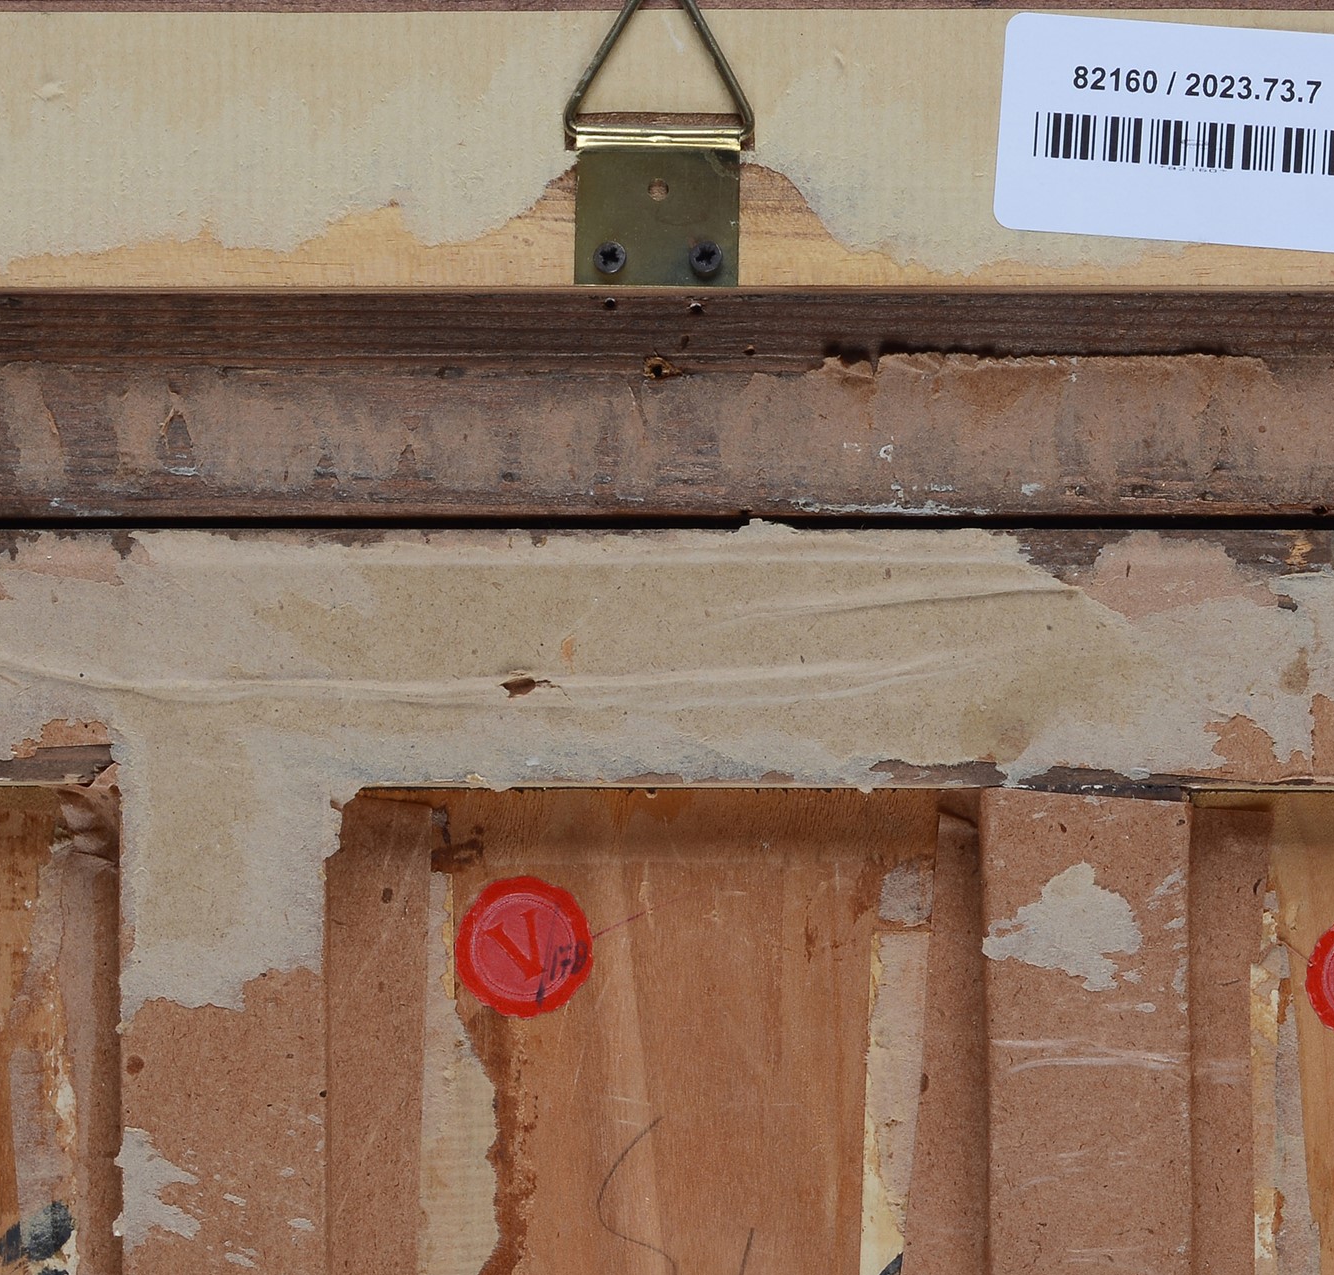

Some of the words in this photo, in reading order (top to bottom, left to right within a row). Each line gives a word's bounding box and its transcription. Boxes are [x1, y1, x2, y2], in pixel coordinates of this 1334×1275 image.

[1073, 66, 1158, 94] 82160
[1166, 71, 1177, 96] /
[1185, 73, 1323, 104] 2023.73.7
[485, 909, 547, 982] V
